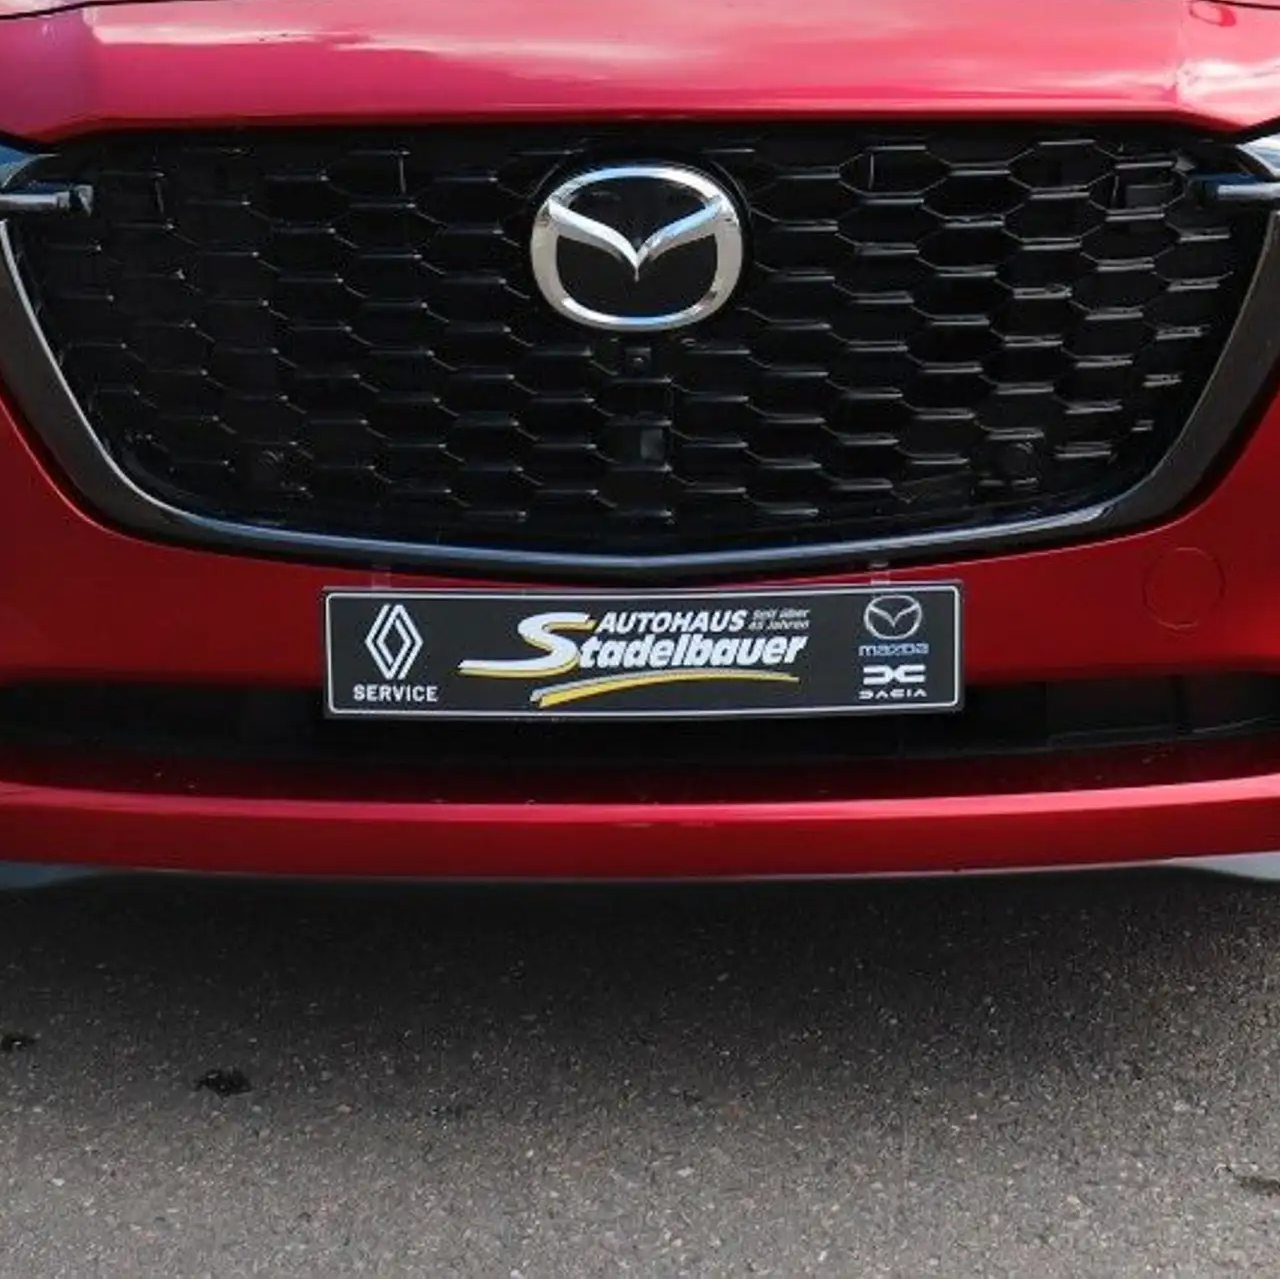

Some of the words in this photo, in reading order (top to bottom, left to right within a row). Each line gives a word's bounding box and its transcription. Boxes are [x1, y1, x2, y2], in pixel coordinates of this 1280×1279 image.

[595, 609, 748, 634] AUTOHAUS
[458, 612, 809, 678] Stadelbauer
[858, 643, 929, 657] mazda
[352, 683, 439, 703] SERVICE
[858, 688, 927, 700] DACIA
